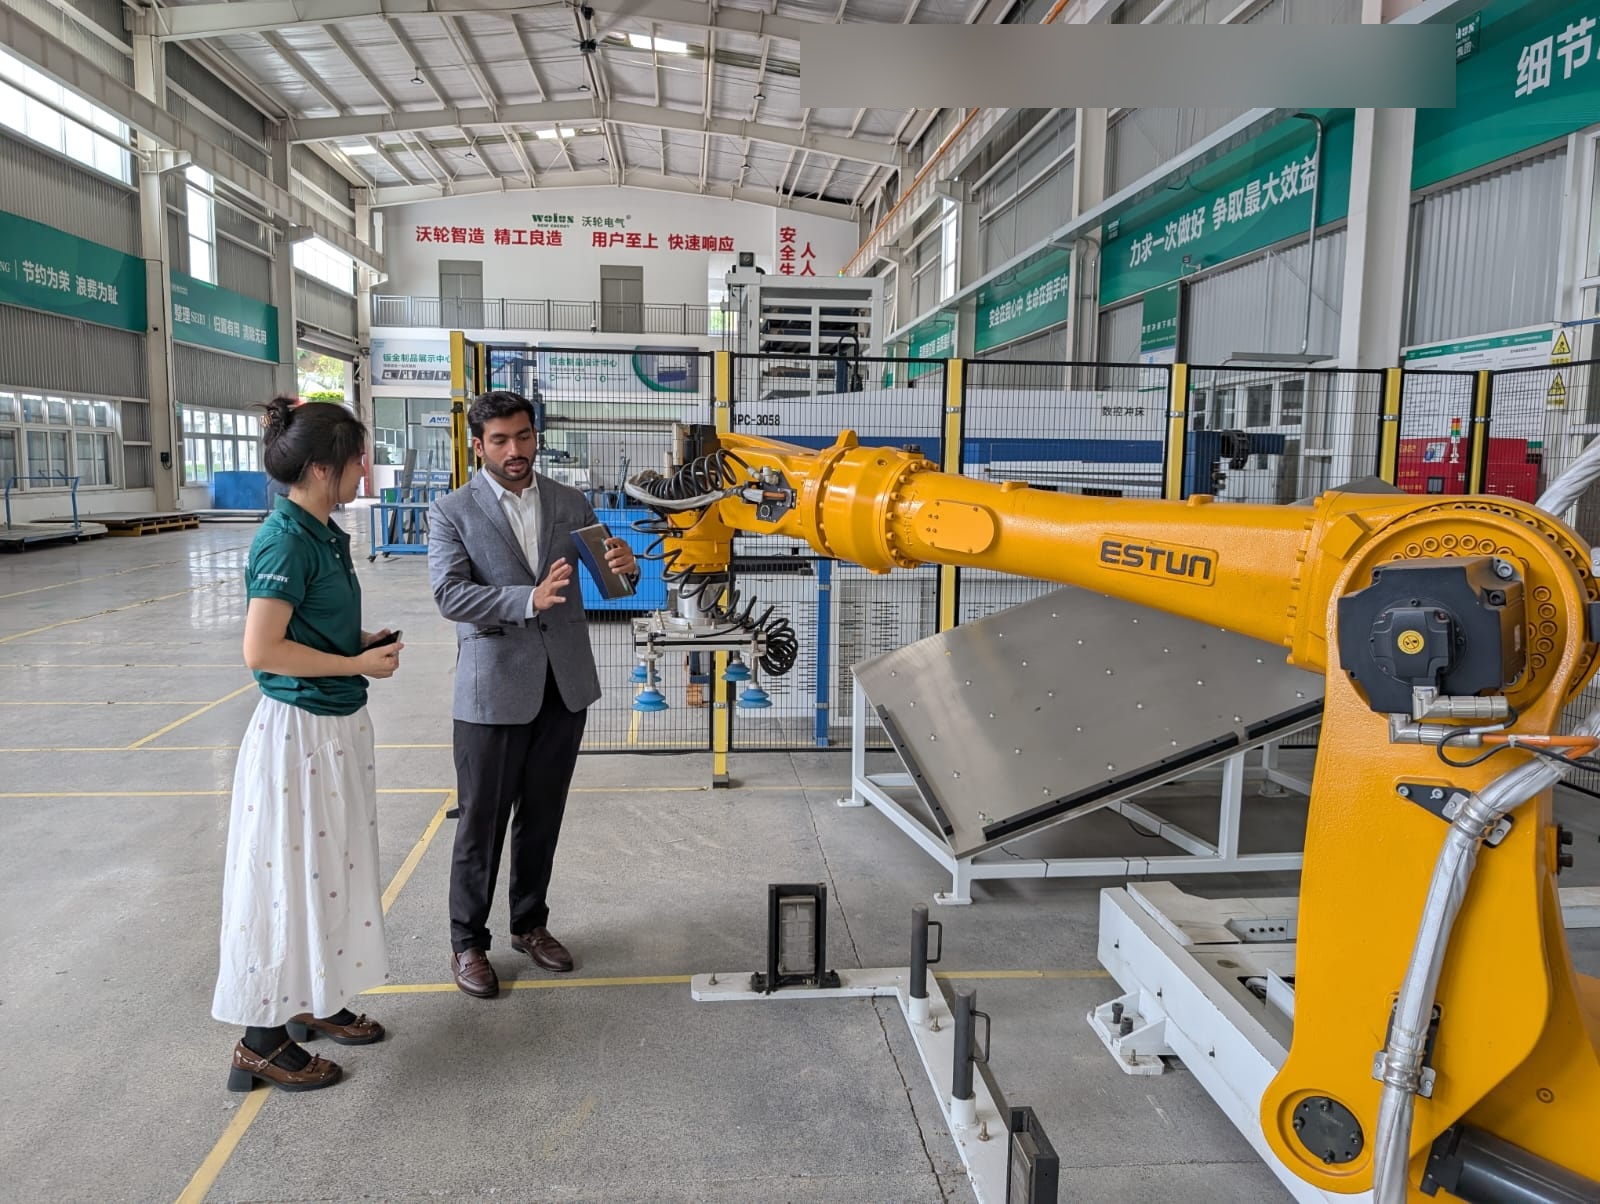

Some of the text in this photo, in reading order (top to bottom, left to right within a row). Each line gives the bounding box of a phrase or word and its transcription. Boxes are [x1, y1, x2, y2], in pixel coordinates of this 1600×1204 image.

[1515, 15, 1600, 98] 细节
[582, 216, 625, 228] 沃轮电气
[1129, 151, 1318, 268] 力求一次做好 争取最大效益
[416, 226, 735, 252] 沃轮智造 精工良造 用户至上 快速响应
[779, 226, 796, 275] 安全生
[800, 241, 816, 276] 人人
[22, 260, 119, 305] 节约为荣 浪费为耻
[989, 273, 1068, 328] 安全在我心中 生命在我手中
[1102, 406, 1145, 417] 数控冲床
[1100, 540, 1212, 580] ESTUN
